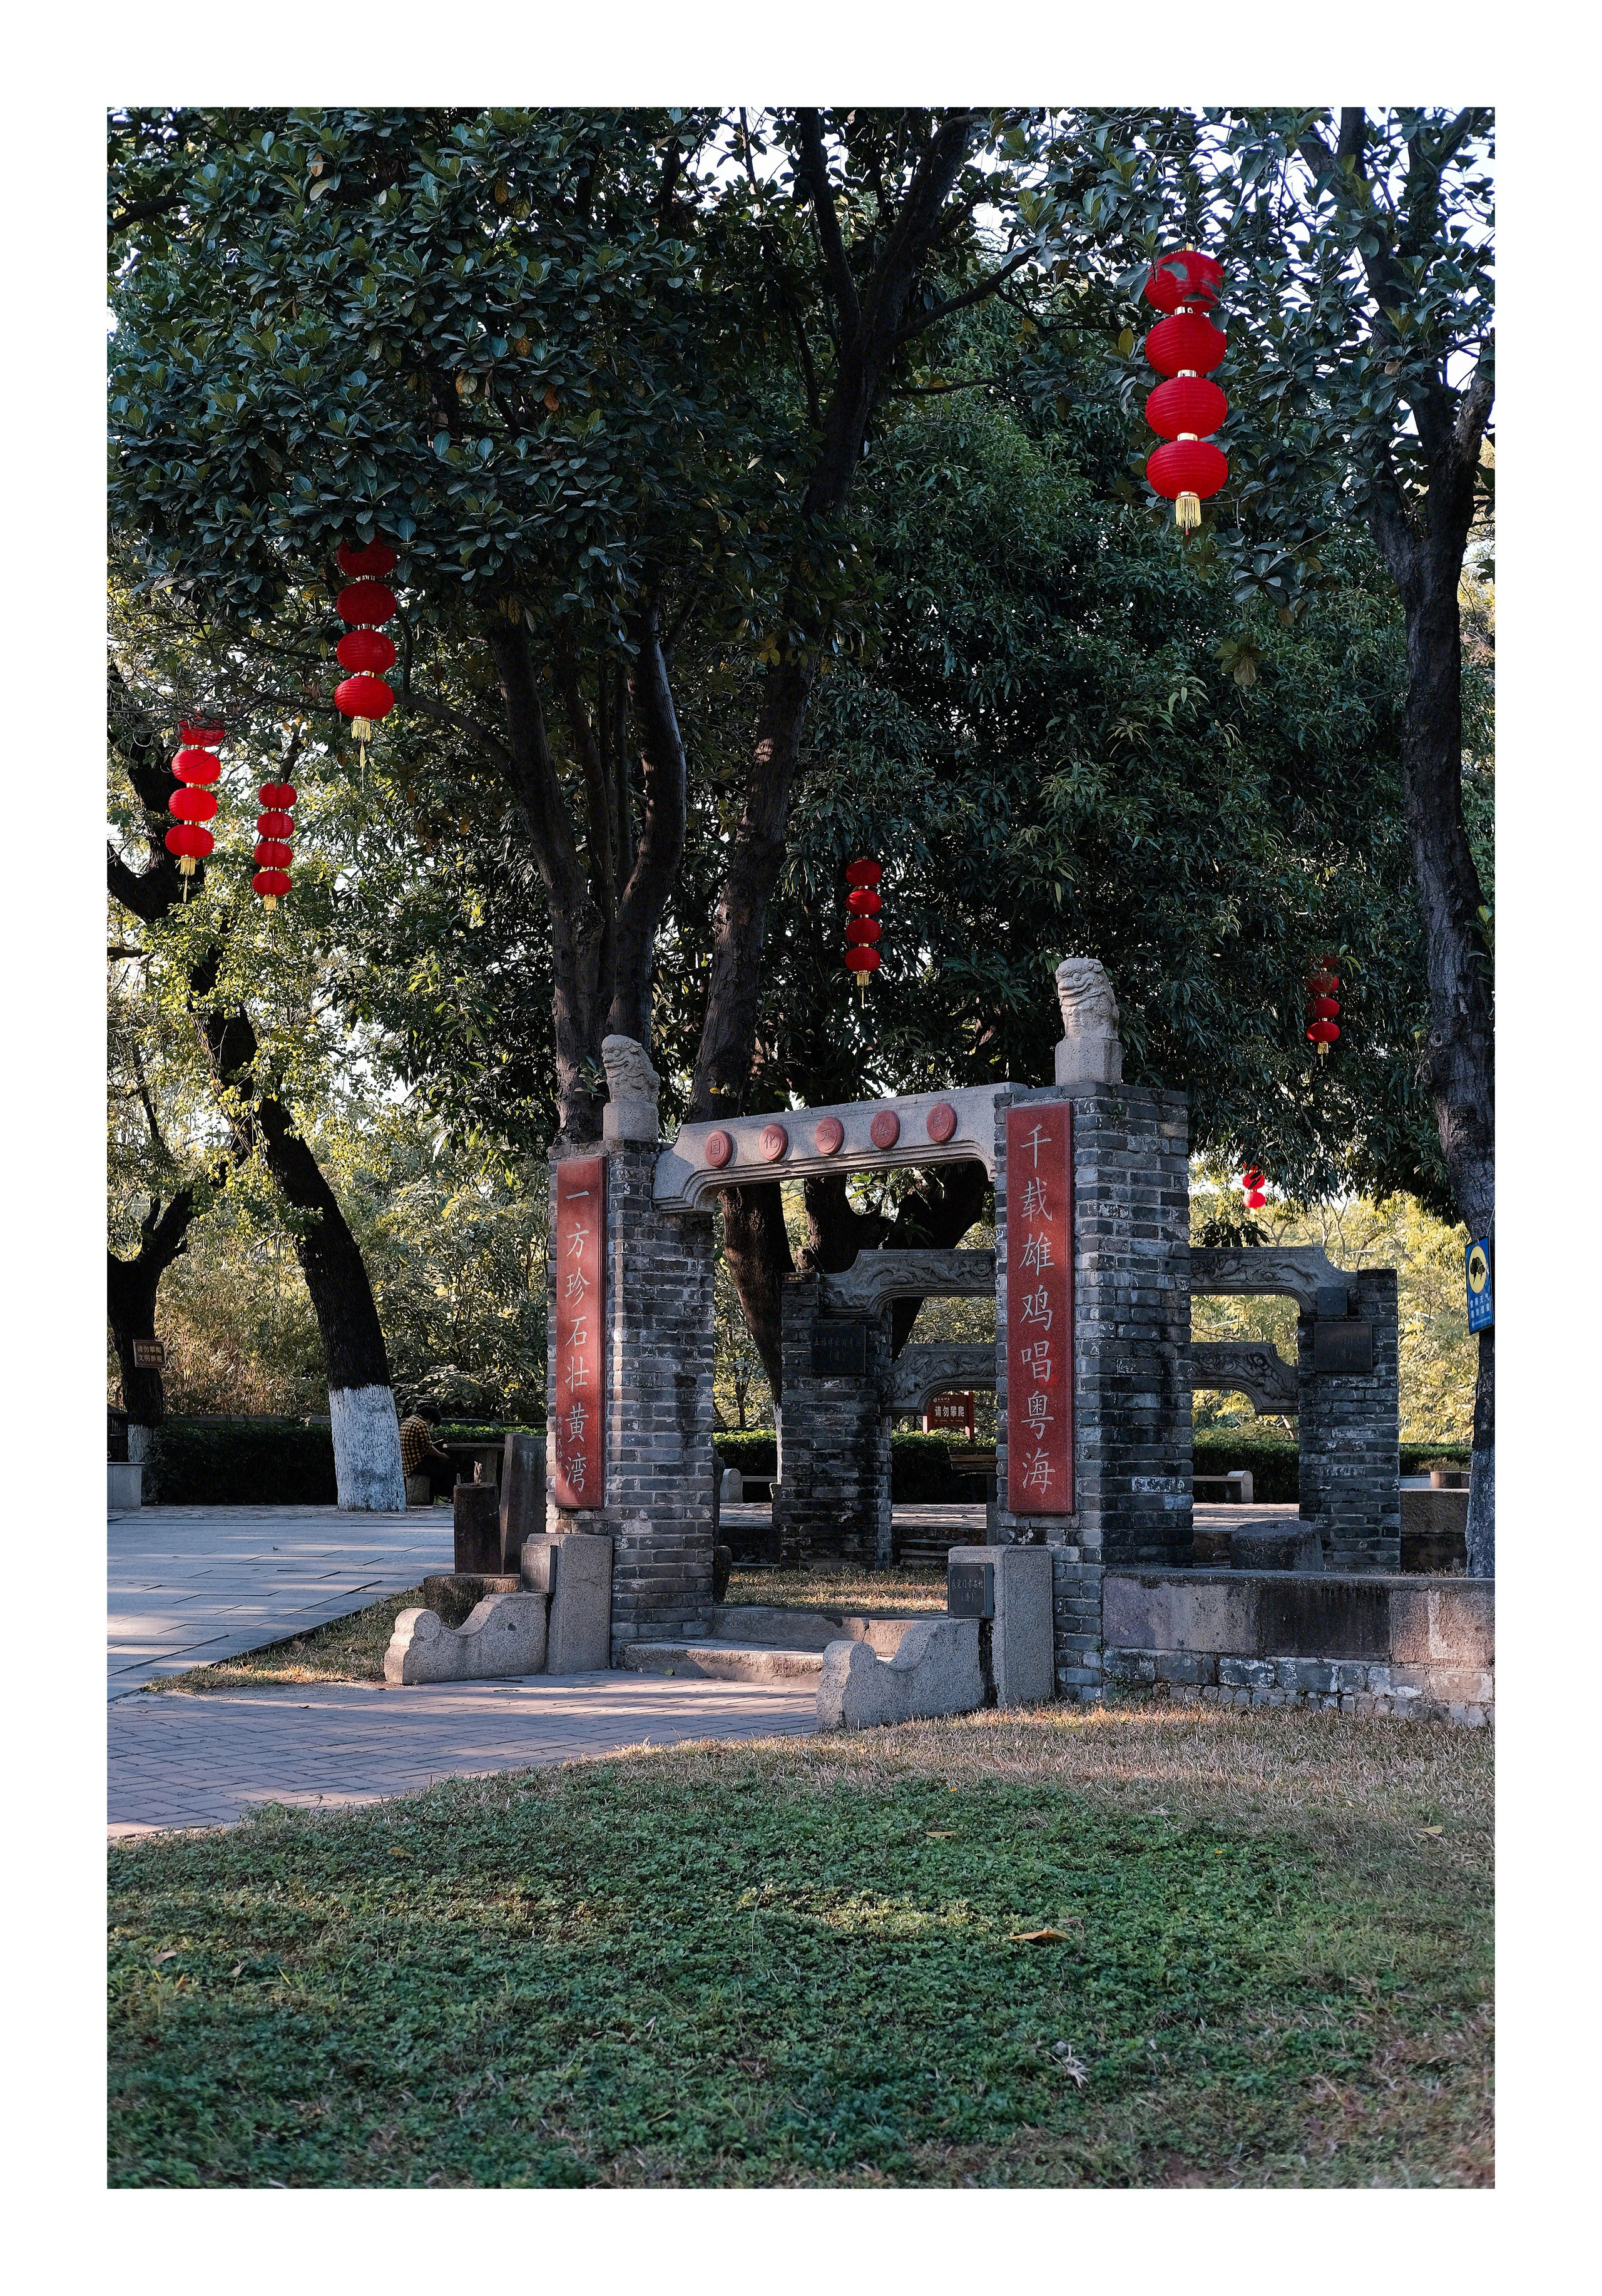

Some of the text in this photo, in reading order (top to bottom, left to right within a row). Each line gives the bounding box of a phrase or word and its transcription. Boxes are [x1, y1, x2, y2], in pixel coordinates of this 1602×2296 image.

[1018, 1124, 1056, 1494] 千载雄鸡唱粤海
[565, 1190, 591, 1492] 一方珍石壮黄湾
[137, 1345, 162, 1354] 请勿攀爬
[138, 1354, 163, 1363] 文明参观
[934, 1405, 965, 1417] 请勿攀爬
